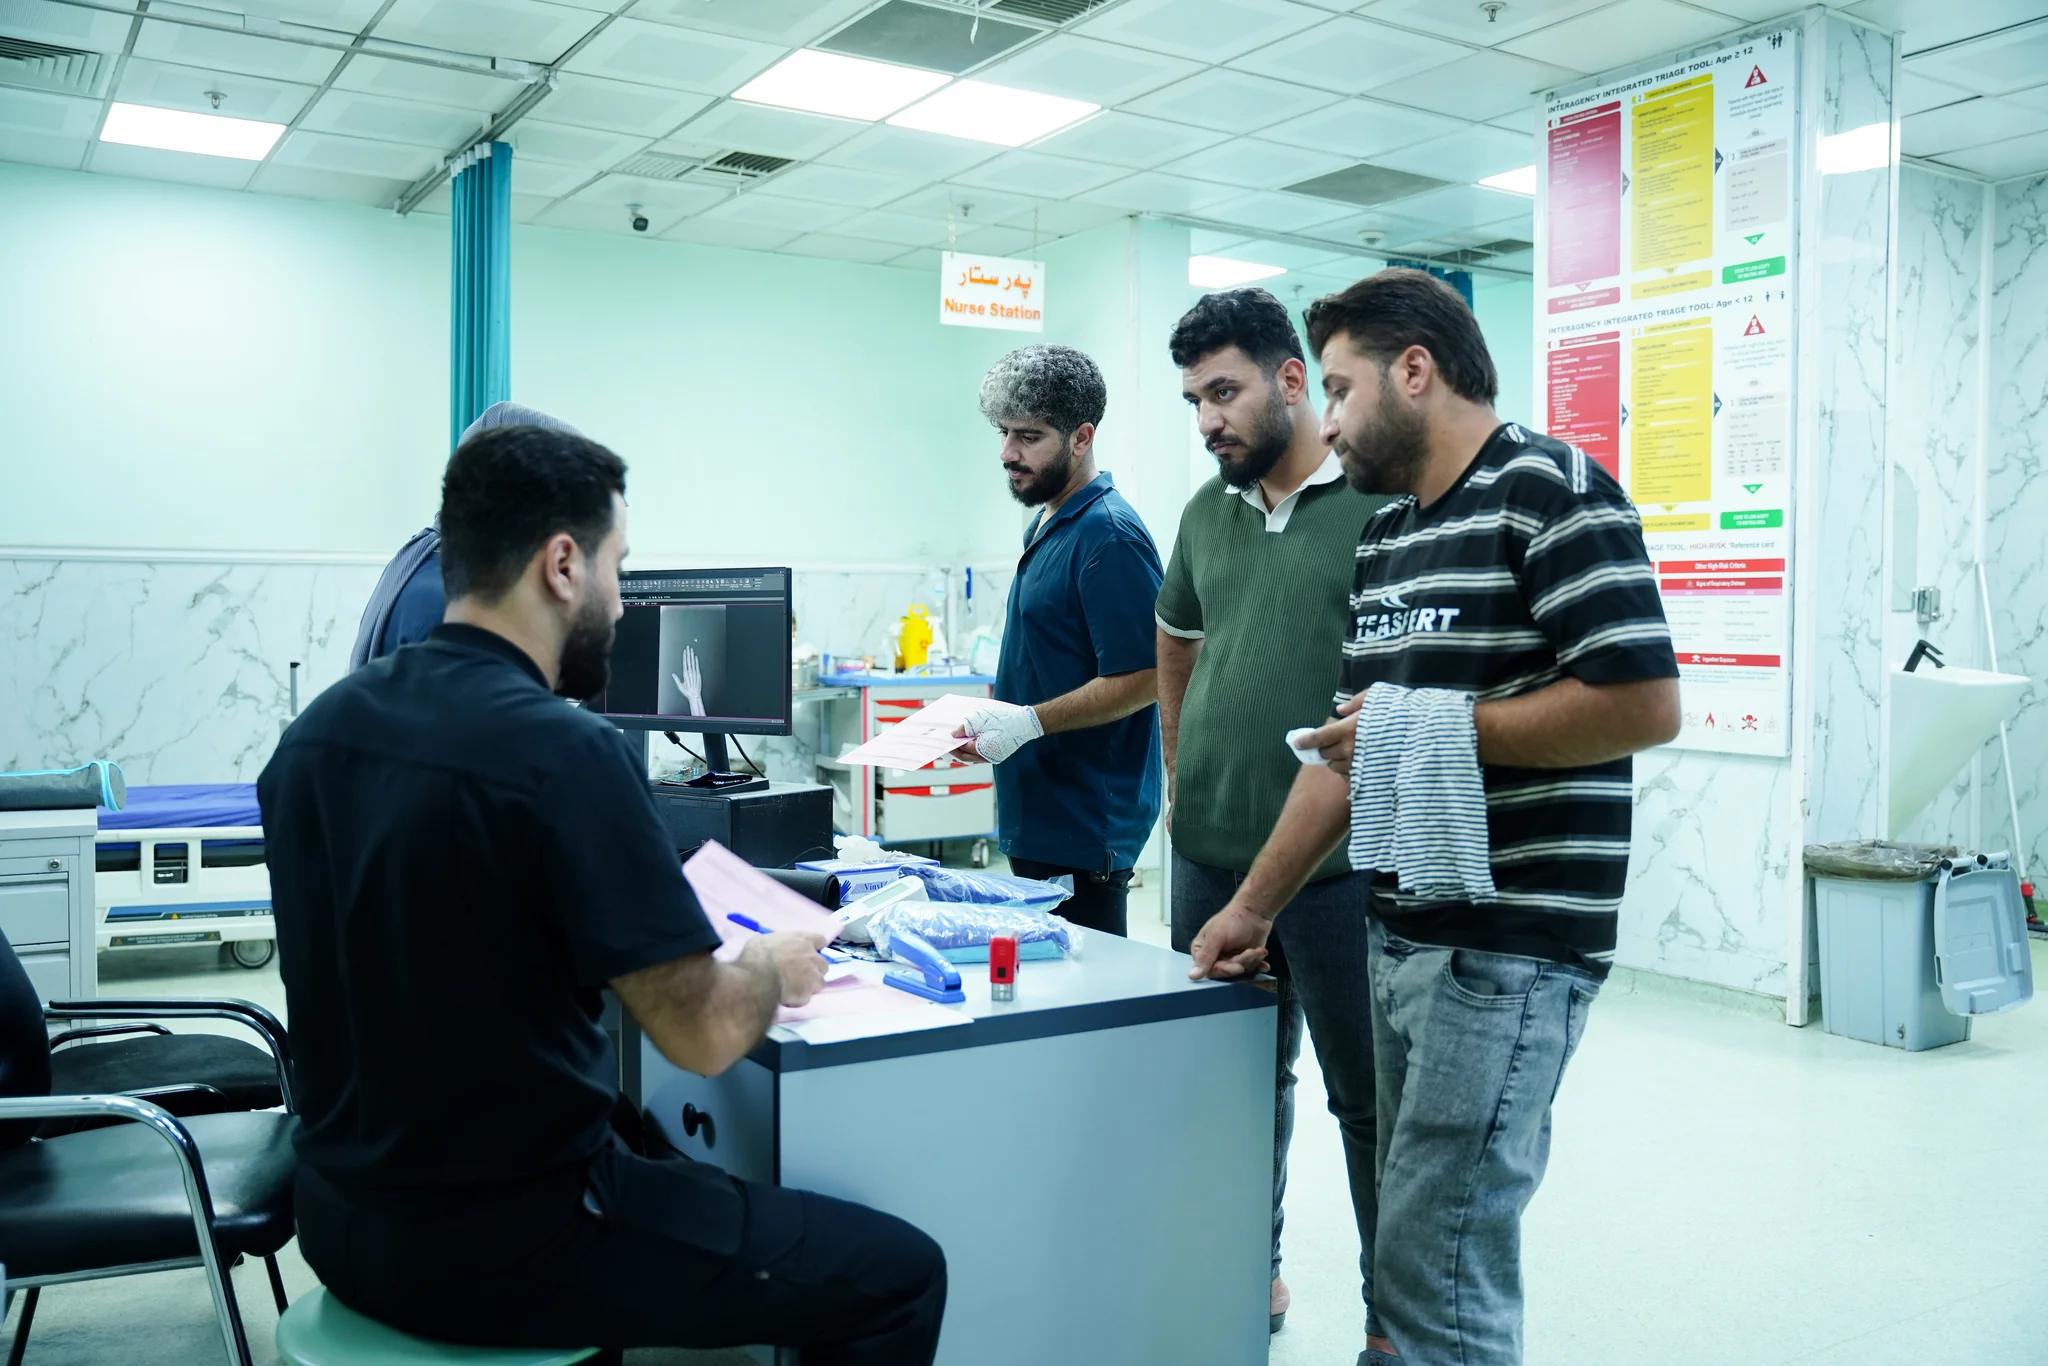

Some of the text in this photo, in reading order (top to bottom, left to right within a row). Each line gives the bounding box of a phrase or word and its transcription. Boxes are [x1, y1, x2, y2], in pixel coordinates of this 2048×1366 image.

[1547, 93, 1600, 113] INTERAGENCY
[1602, 78, 1652, 97] INTEGRATED
[1655, 67, 1685, 82] TRIAGE
[1688, 60, 1713, 73] TOOL:
[1715, 54, 1732, 64] Age
[1743, 46, 1753, 55] 12
[945, 297, 1041, 320] Nurse Station
[1549, 320, 1601, 334] INTERAGENCY
[1603, 311, 1653, 325] INTEGRATED
[1656, 306, 1686, 317] TRIAGE
[1689, 302, 1713, 312] TOOL:
[1716, 300, 1732, 309] Age
[1743, 294, 1753, 302] 12
[1695, 562, 1708, 570] Other
[1708, 562, 1728, 571] High-Risk
